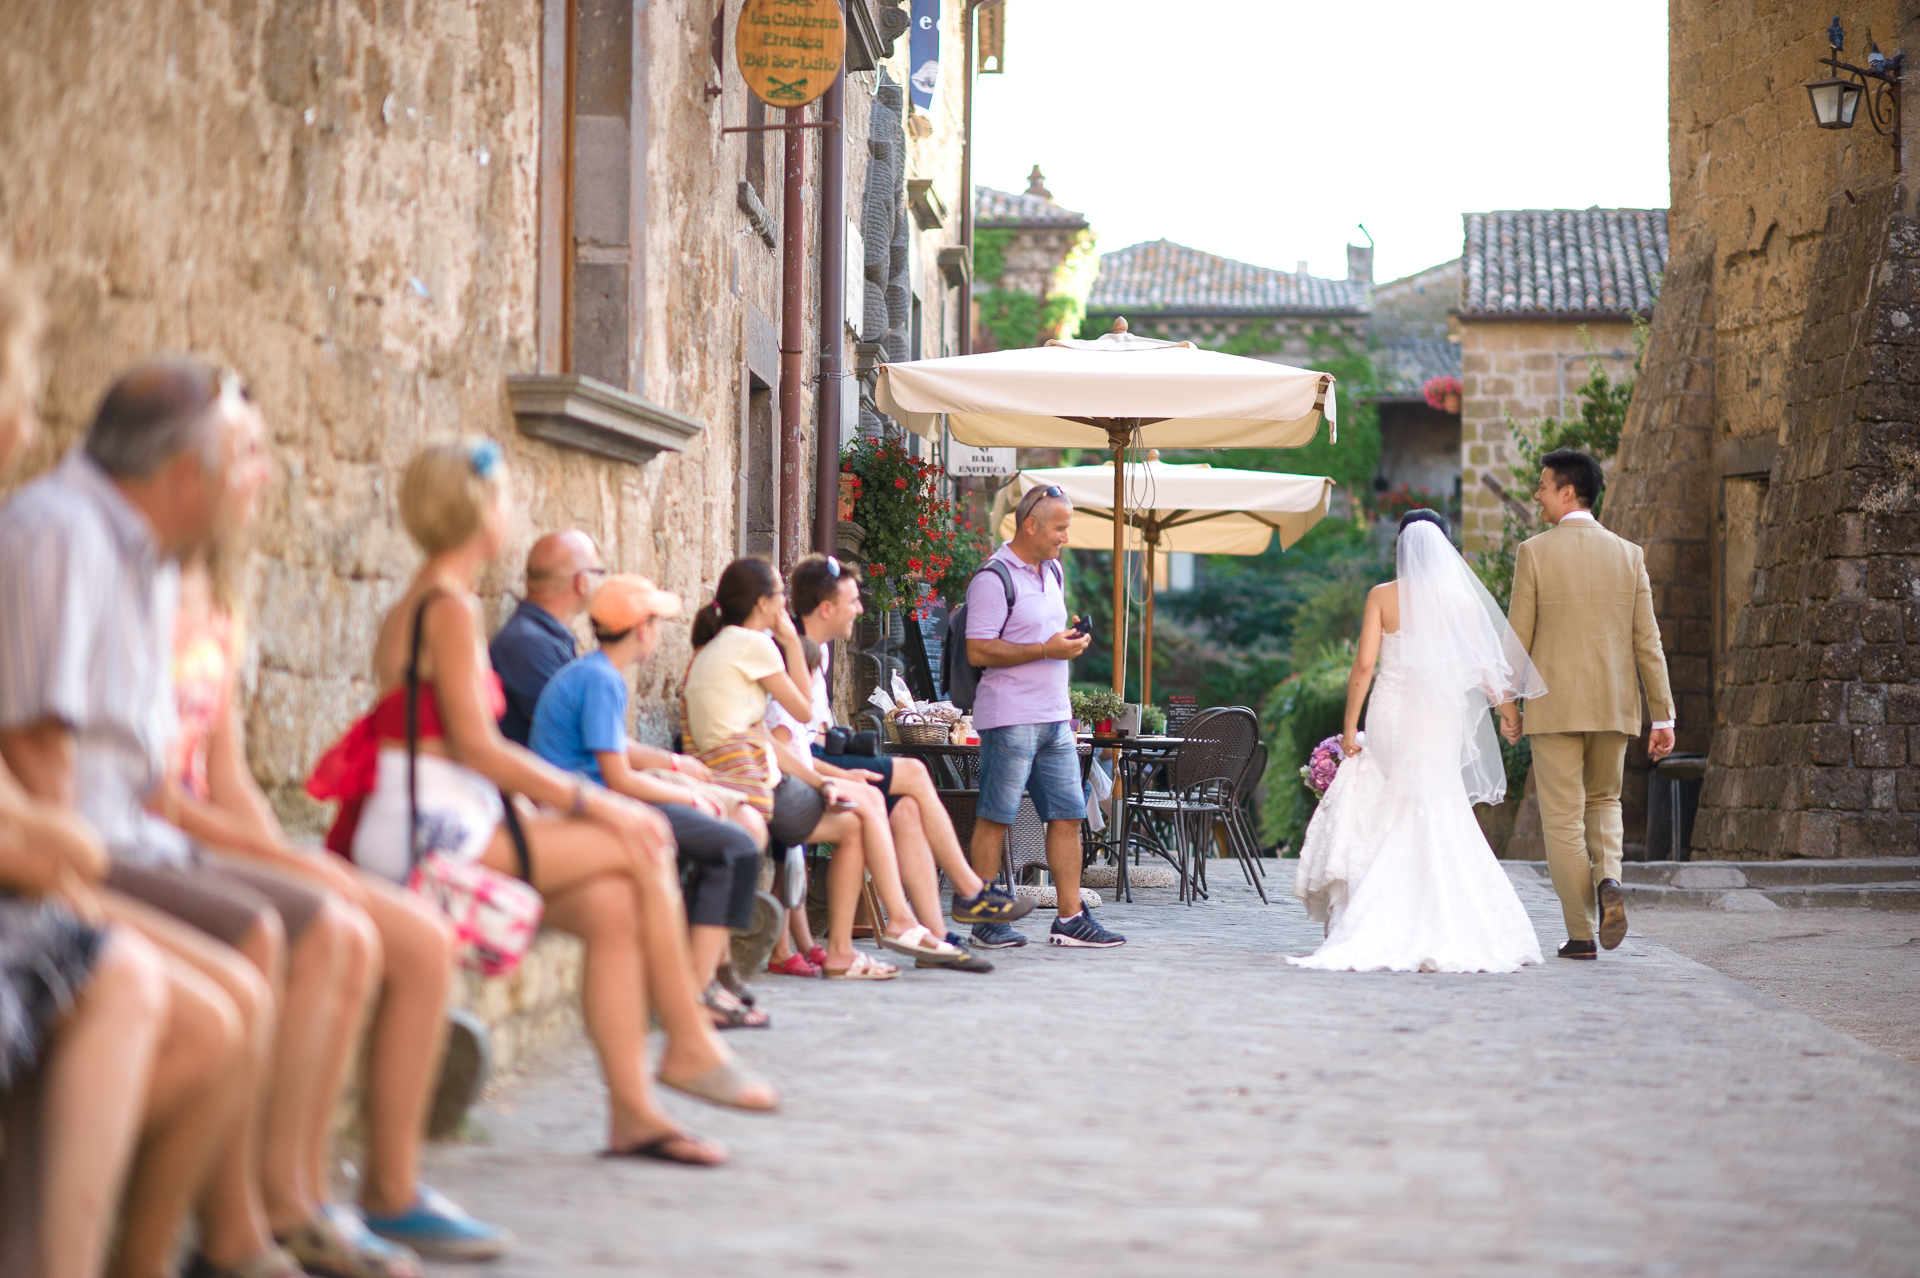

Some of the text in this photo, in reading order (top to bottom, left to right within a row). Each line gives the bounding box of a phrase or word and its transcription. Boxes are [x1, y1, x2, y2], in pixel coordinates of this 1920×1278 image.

[750, 10, 839, 29] La Cisterna
[763, 31, 824, 49] Etrusca
[772, 54, 798, 69] Sor
[958, 465, 1007, 473] ENOTECA
